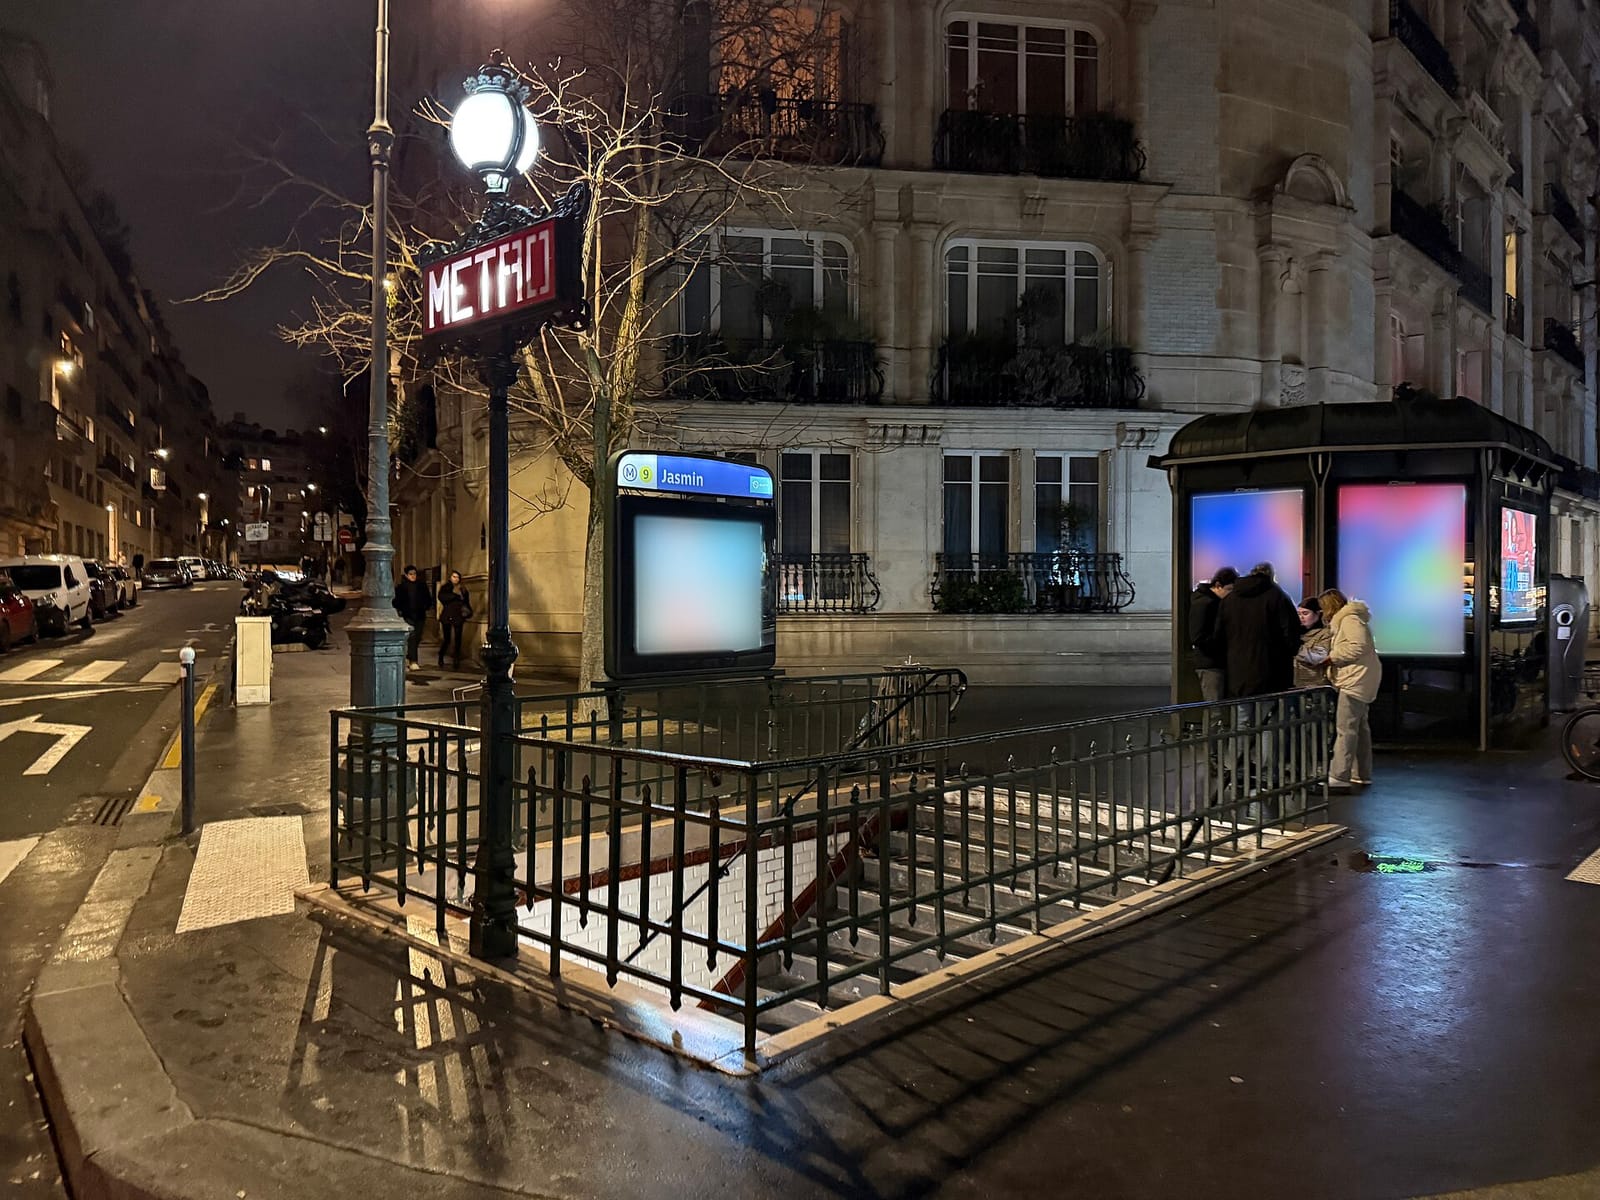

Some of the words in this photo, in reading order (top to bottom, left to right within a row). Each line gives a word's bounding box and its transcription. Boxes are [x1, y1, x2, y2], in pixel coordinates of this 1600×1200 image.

[428, 229, 550, 329] METRO
[642, 469, 649, 480] 9
[661, 469, 704, 487] Jasmin
